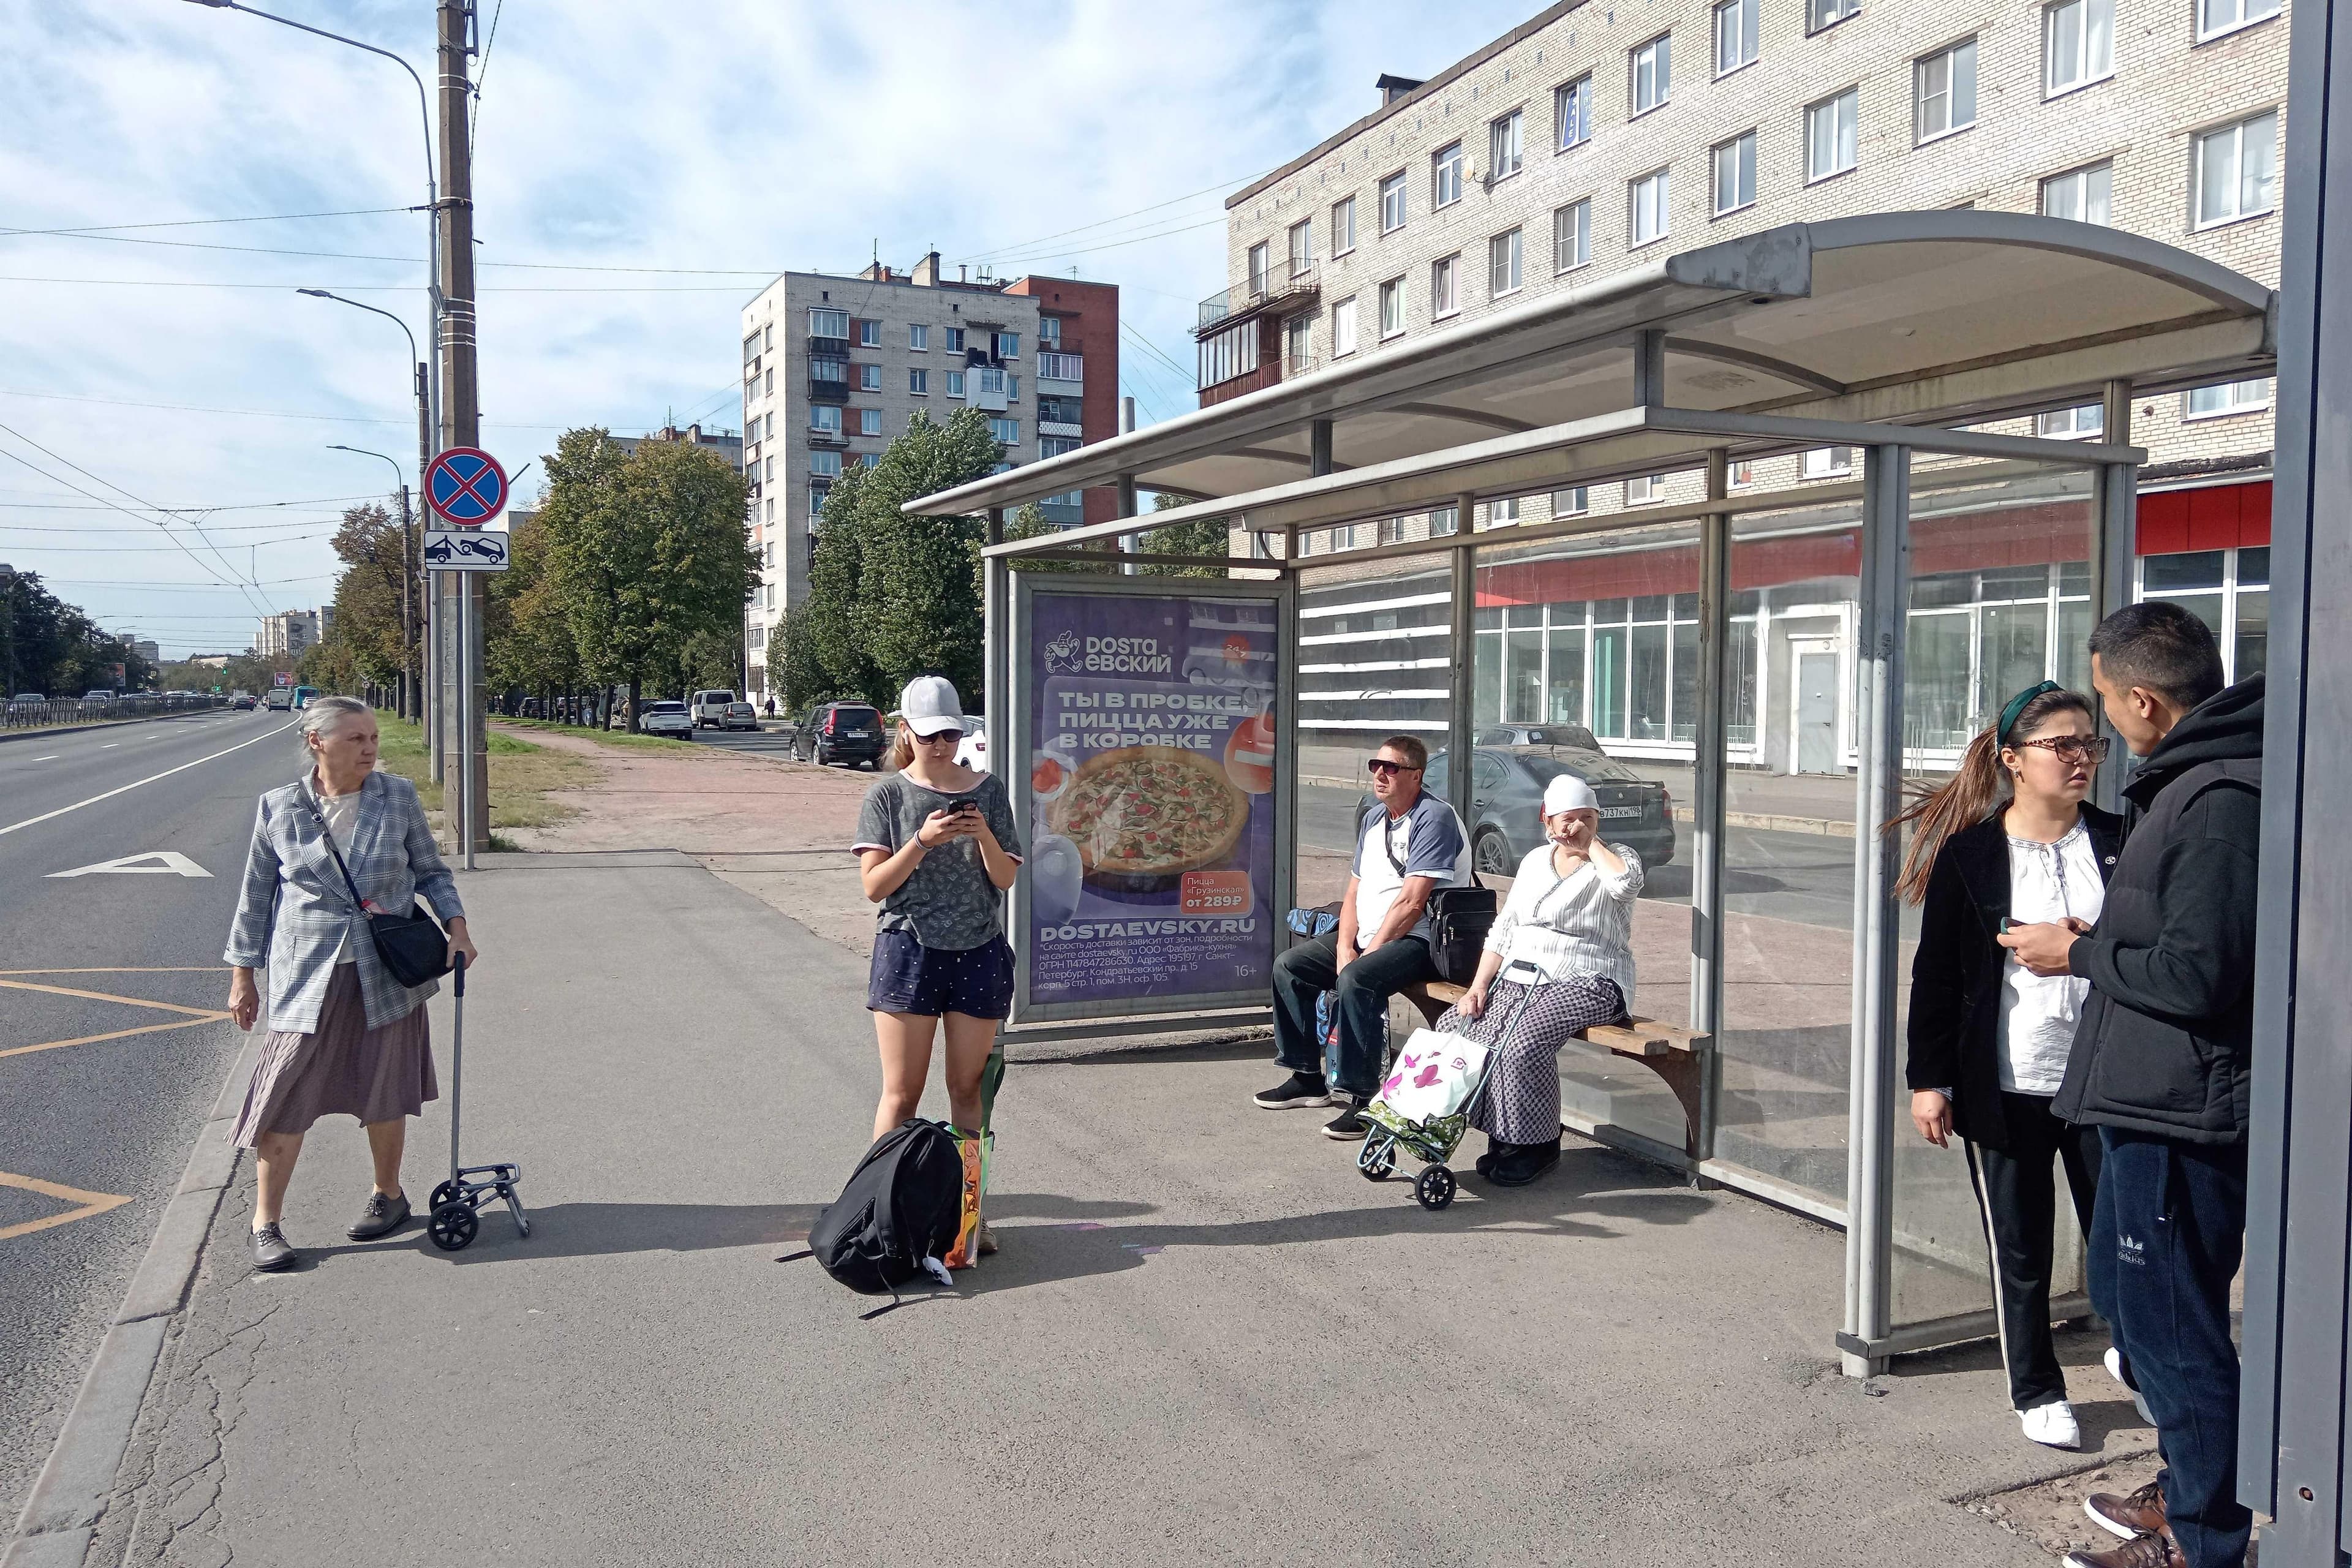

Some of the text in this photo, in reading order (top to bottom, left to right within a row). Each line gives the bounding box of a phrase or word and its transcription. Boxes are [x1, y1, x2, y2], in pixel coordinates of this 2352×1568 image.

[1058, 692, 1249, 713] ТЫ В ПРОБКЕ,
[1059, 712, 1229, 732] ПИЦЦА УЖЕ
[1059, 733, 1212, 749] В КОРОБКЕ
[1187, 886, 1245, 896] «Грузинская»
[1041, 919, 1256, 942] DOSTAEVSKY.RU
[1085, 940, 1126, 949] доставки
[1194, 934, 1253, 943] подробности
[1050, 951, 1076, 960] сайте
[1139, 945, 1161, 955] ООО
[1163, 944, 1237, 954] «Фабрика-кухня»
[1039, 960, 1065, 970] ОГРН
[1137, 956, 1167, 965] Адрес
[1205, 952, 1235, 960] Санкт-
[1090, 964, 1163, 976] Кондратьевский
[1189, 962, 1198, 970] 15
[1234, 965, 1257, 977] 16+
[1038, 981, 1063, 990] корп.
[1064, 979, 1070, 987] 5
[1071, 979, 1088, 989] стр.
